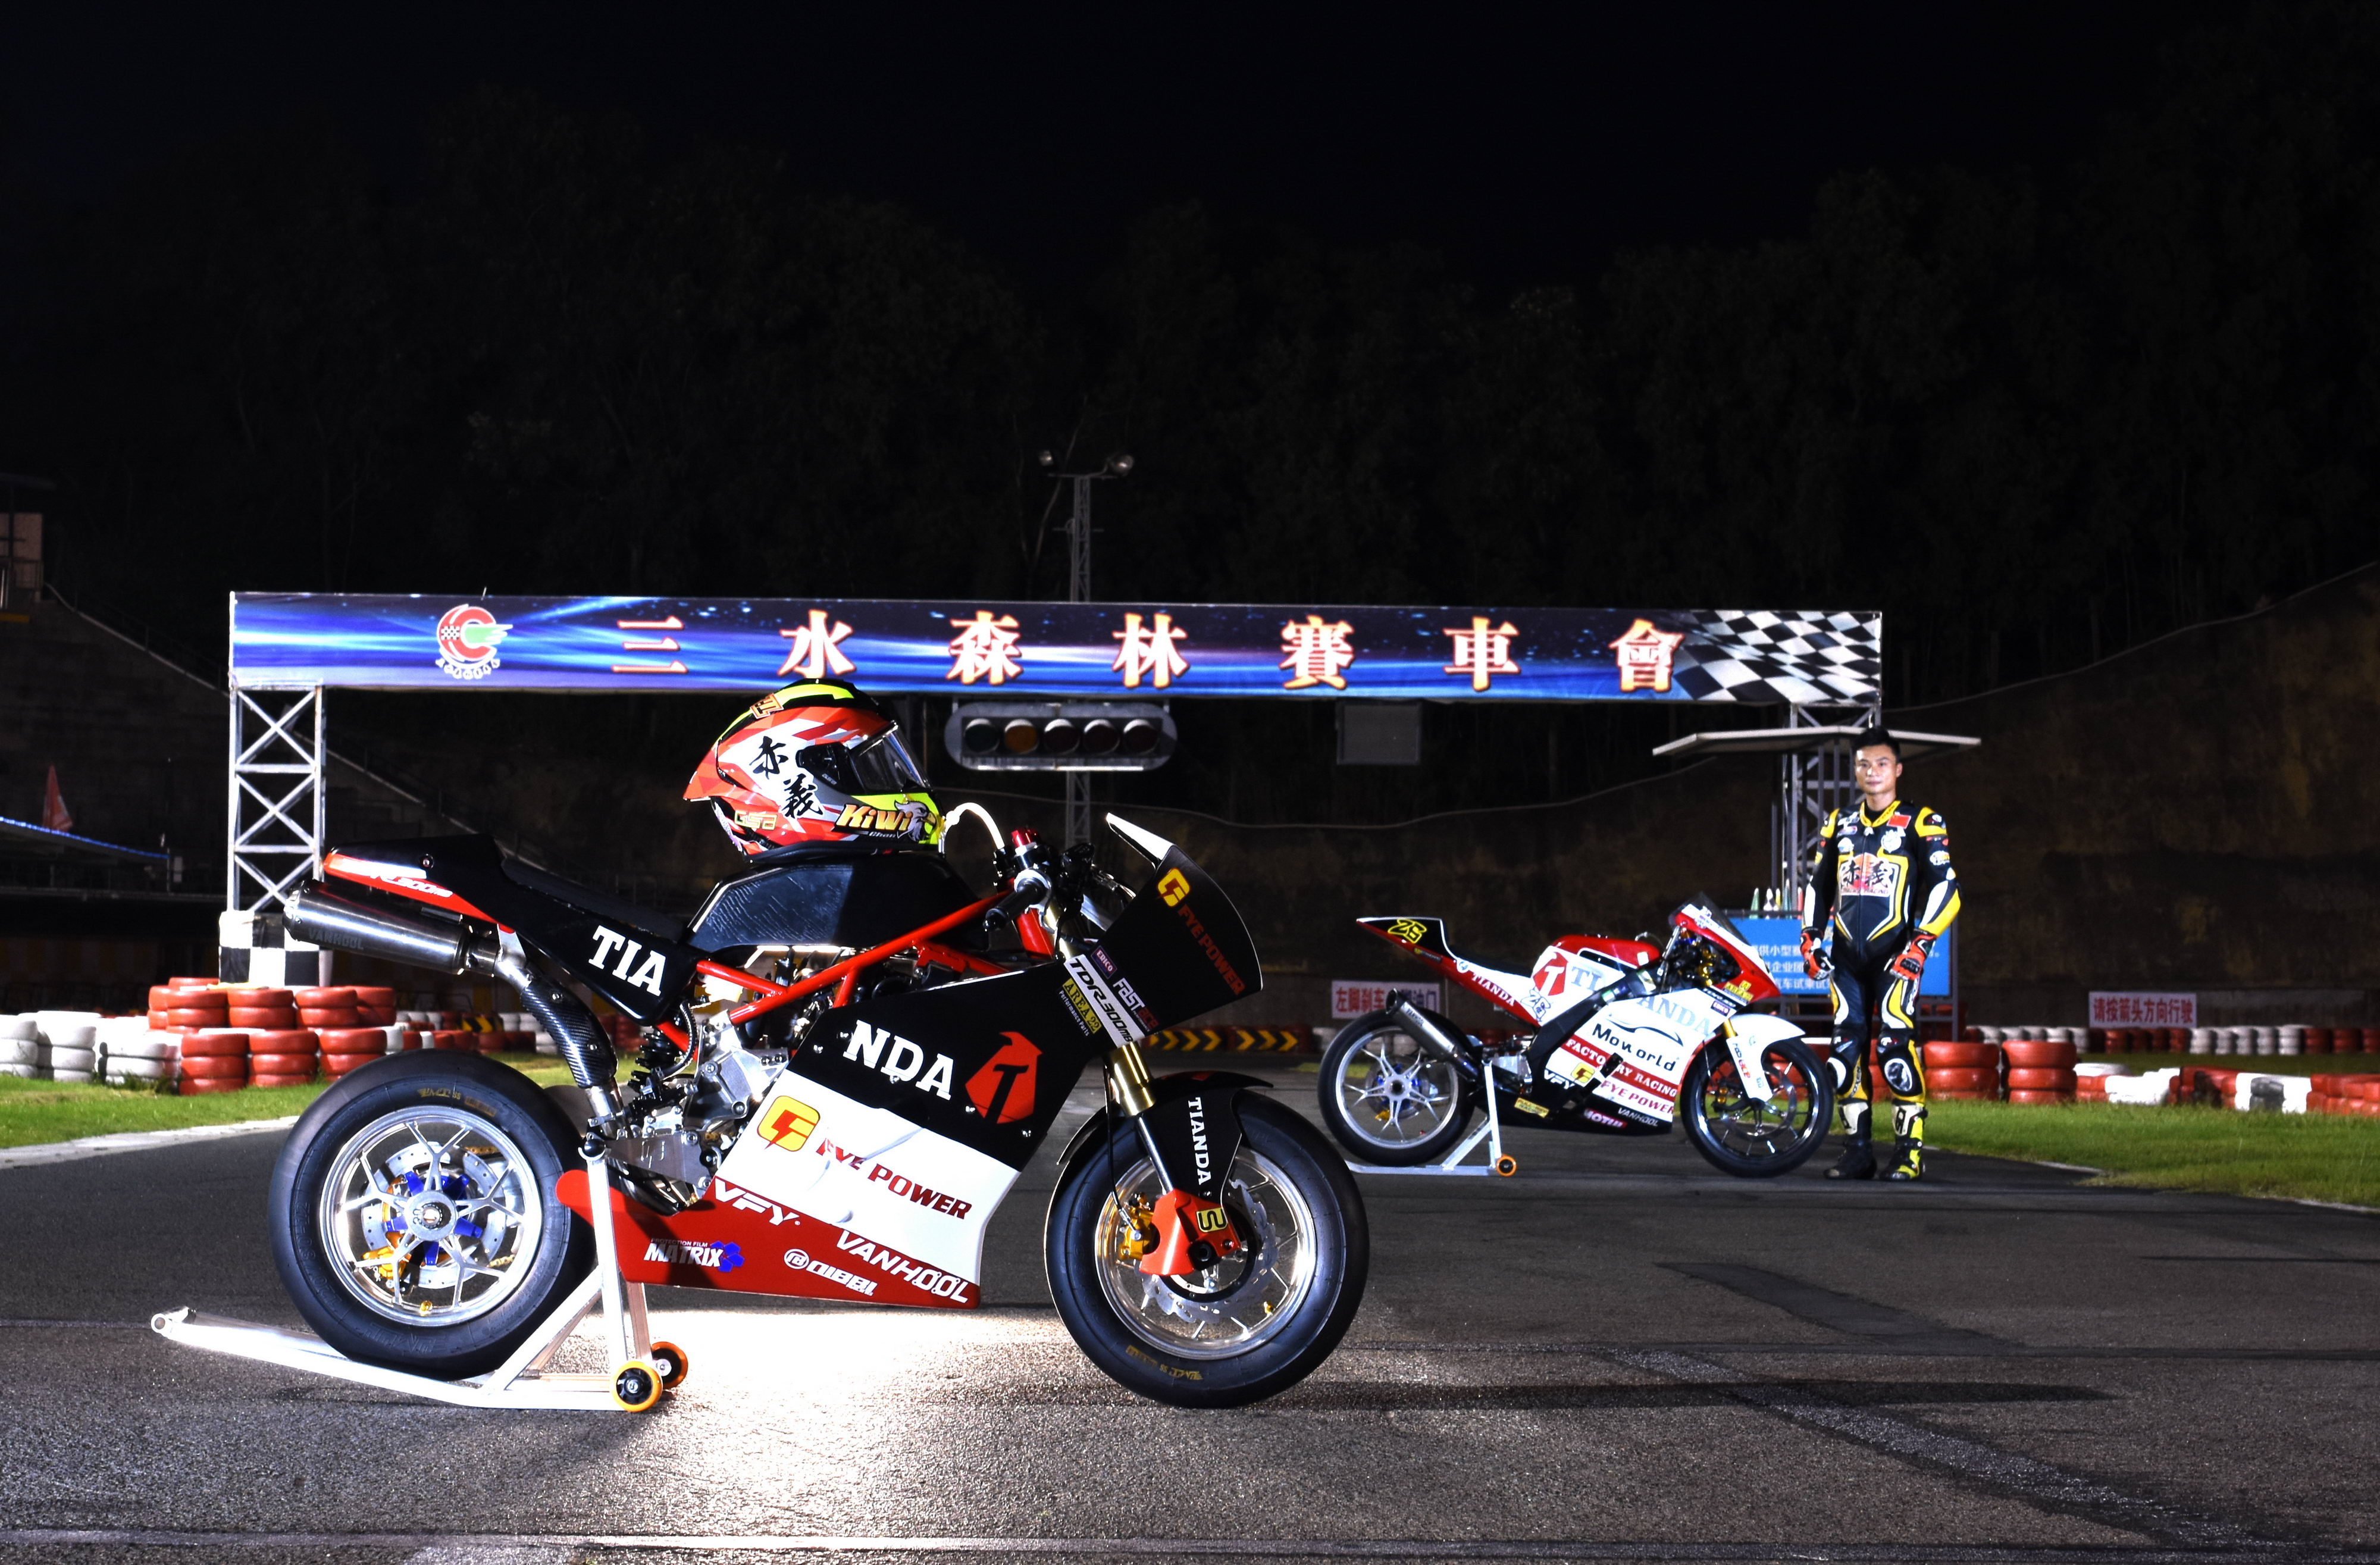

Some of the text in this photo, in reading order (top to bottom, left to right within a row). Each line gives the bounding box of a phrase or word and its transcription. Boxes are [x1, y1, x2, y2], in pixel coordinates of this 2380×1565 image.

[611, 609, 1684, 693] 三水森林賽車會
[588, 925, 668, 997] TIA
[1095, 949, 1114, 973] ERICO
[1178, 904, 1246, 996] FYE POWER
[1063, 982, 1102, 1032] AREA 22
[1471, 972, 1517, 1006] TIANDA
[2094, 998, 2193, 1023] 请按箭头方向行驶
[1059, 990, 1090, 1037] Performance Parts
[843, 1020, 954, 1101] NDA
[1601, 1080, 1674, 1114] FYE POWER
[1634, 1073, 1677, 1097] RACING
[1618, 1107, 1659, 1127] VANHOOL
[1188, 1097, 1211, 1185] TIANDA
[868, 1163, 972, 1219] POWER
[644, 1243, 724, 1267] MATRIX
[651, 1238, 691, 1246] PROTECTION
[835, 1229, 968, 1303] VANHOOL
